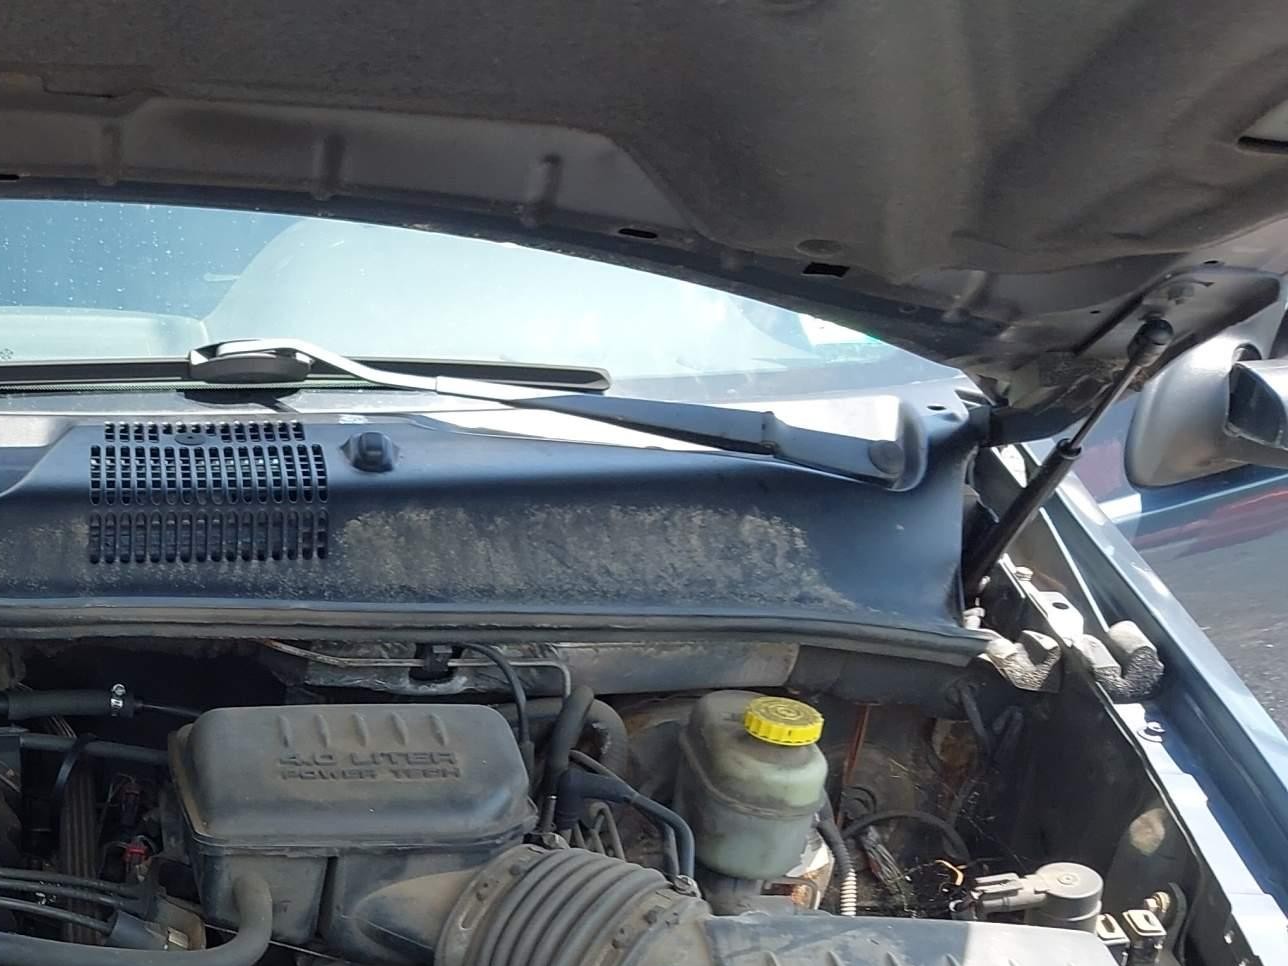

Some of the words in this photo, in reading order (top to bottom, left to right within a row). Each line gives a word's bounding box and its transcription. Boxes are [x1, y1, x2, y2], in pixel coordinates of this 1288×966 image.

[279, 752, 338, 766] 4.0
[349, 752, 457, 765] LITER
[280, 768, 377, 781] POWER
[389, 767, 461, 780] TECH
